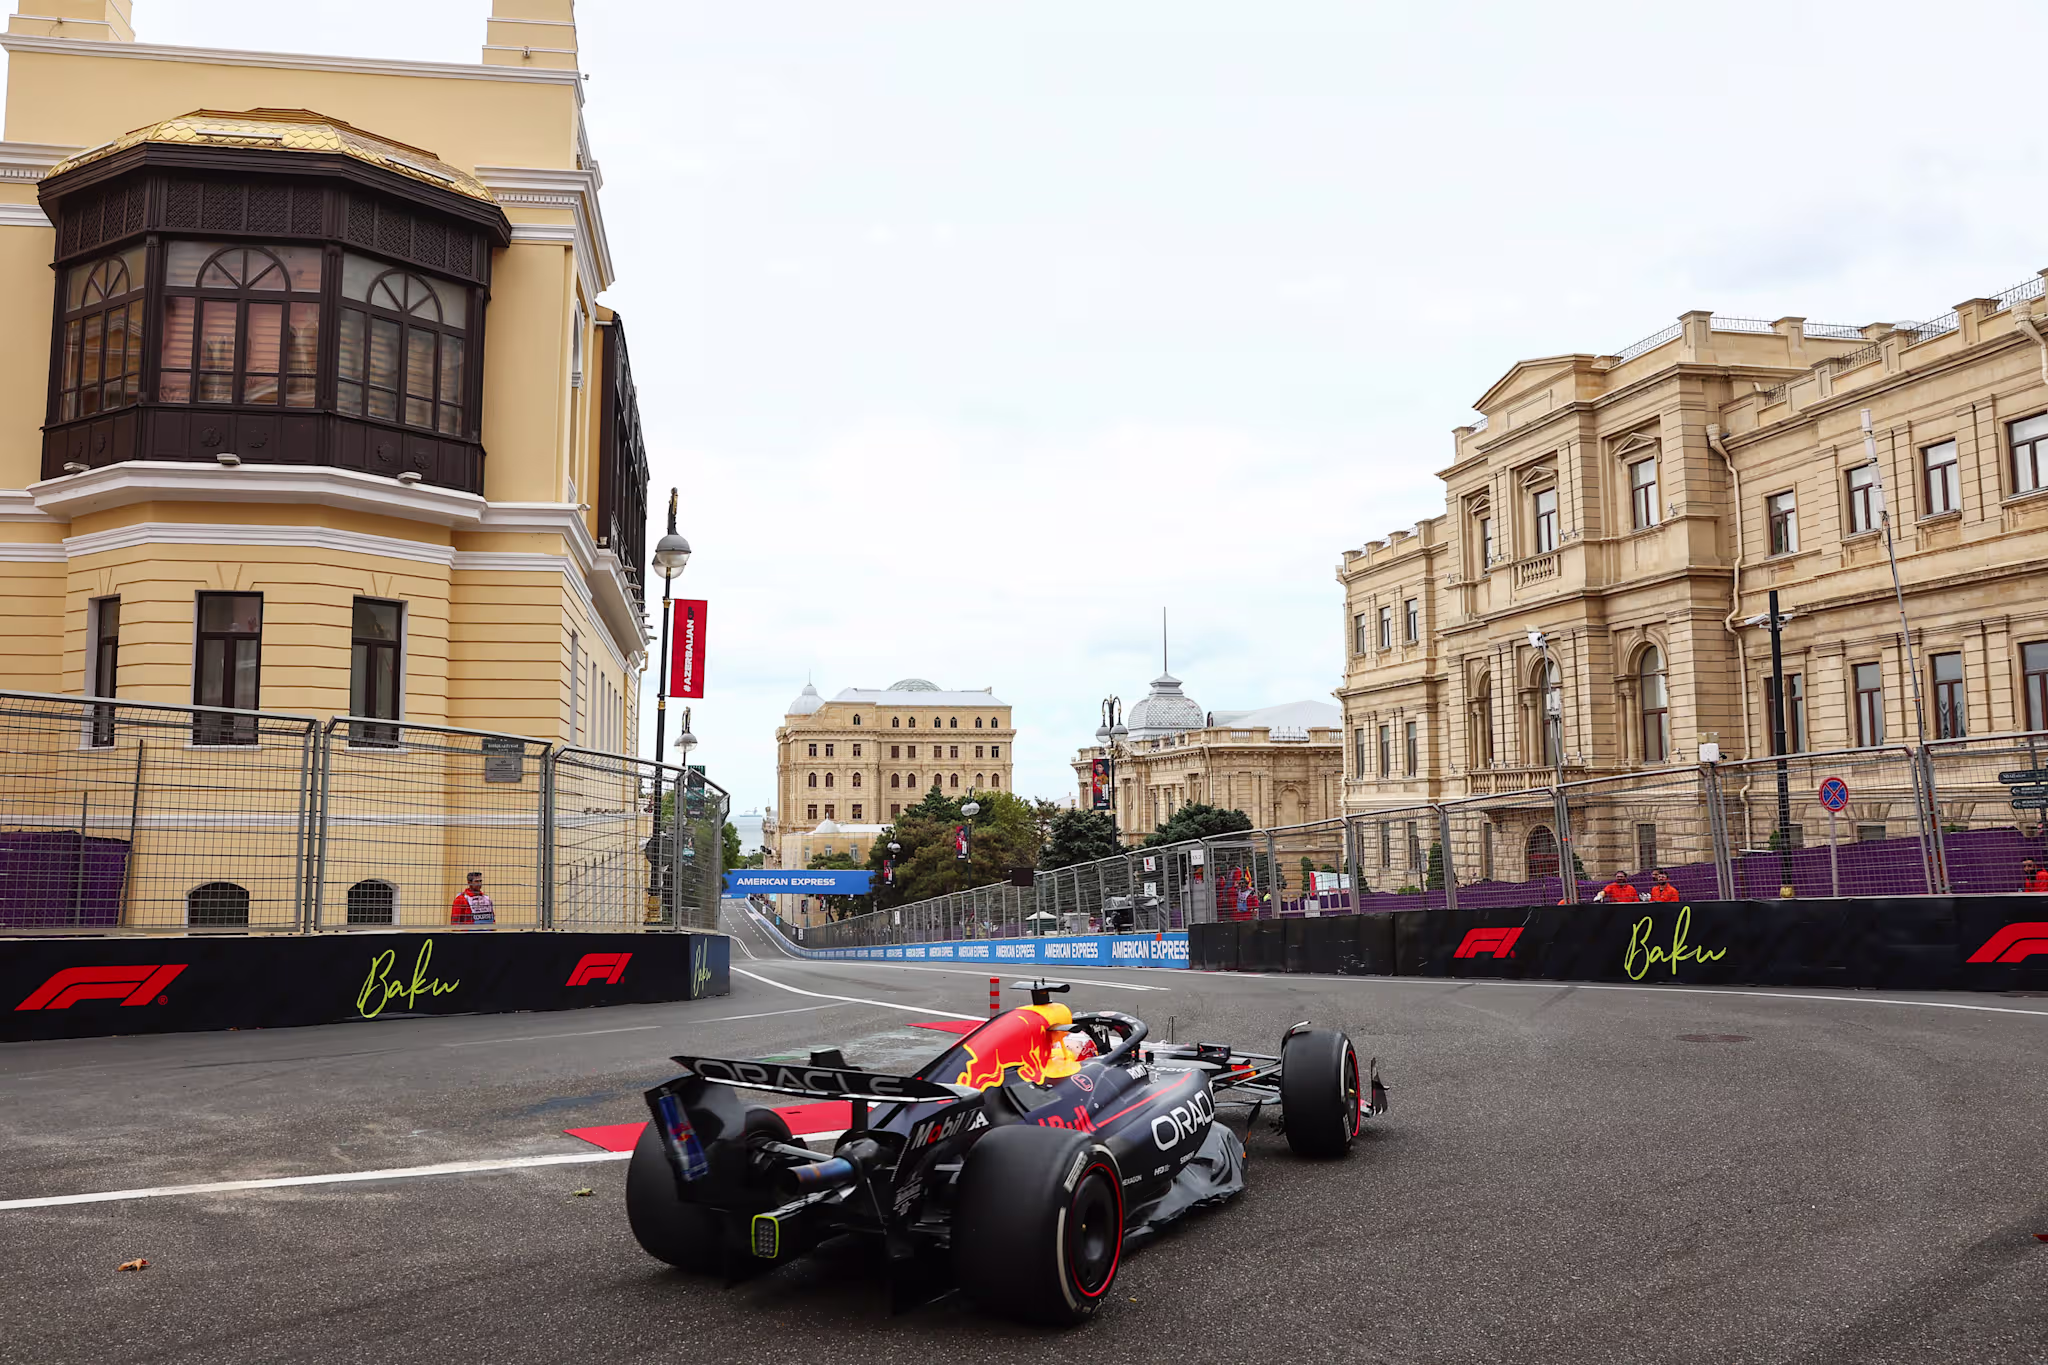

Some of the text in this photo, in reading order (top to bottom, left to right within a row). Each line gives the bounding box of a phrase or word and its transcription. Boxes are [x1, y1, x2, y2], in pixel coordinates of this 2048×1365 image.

[736, 878, 836, 886] AMERICAN EXPRESS
[995, 944, 1035, 958] AMERICAN EXPRESS
[1044, 942, 1098, 958] AMERICAN EXPRESS
[1111, 940, 1189, 960] AMERICAN EXPRESS
[1624, 905, 1727, 981] Baku
[356, 938, 460, 1018] Baku
[693, 938, 711, 996] Baku
[694, 1059, 903, 1095] ORACLE
[911, 1112, 966, 1150] Mobil
[1151, 1080, 1216, 1151] ORACL
